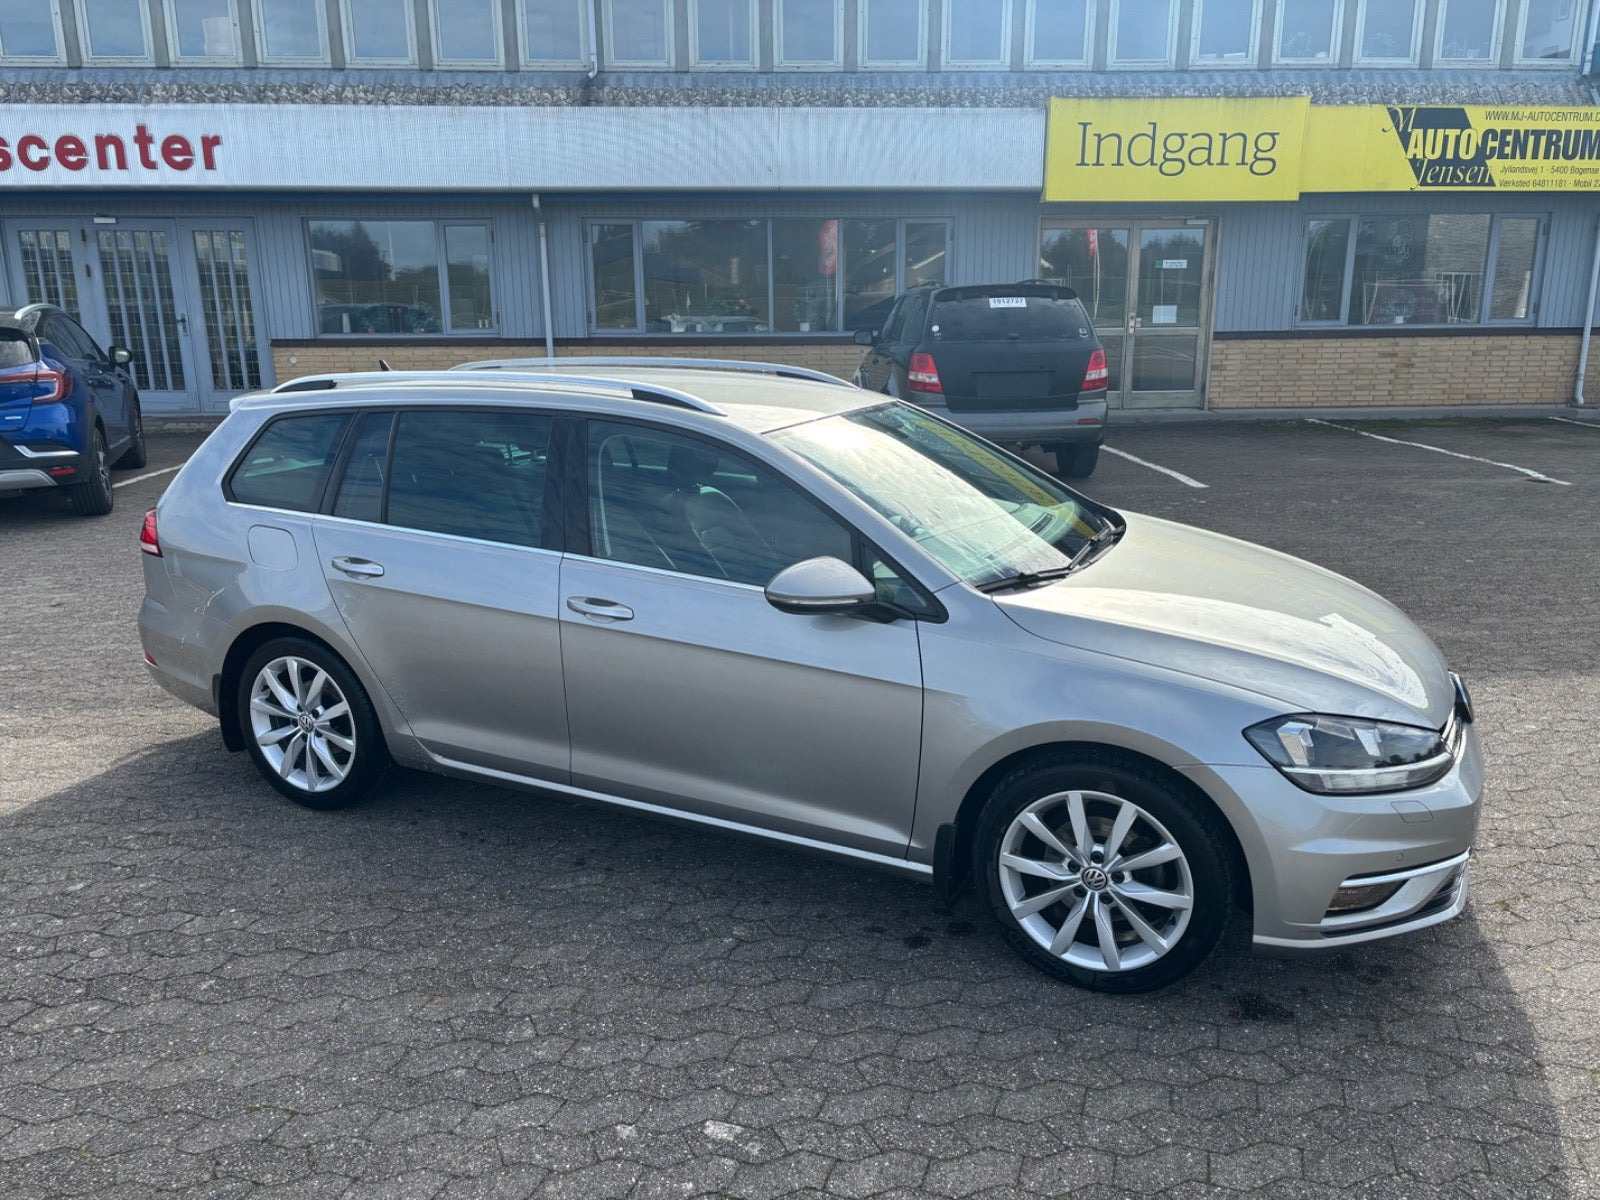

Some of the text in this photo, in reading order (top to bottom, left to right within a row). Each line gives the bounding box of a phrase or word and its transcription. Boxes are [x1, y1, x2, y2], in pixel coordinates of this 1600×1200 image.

[1075, 121, 1280, 177] Indgang
[1405, 128, 1600, 161] AUTO CENTRUM
[1410, 157, 1491, 190] Jensen
[1540, 166, 1544, 174] 1
[1550, 165, 1569, 175] 5400
[1570, 165, 1600, 176] Bogense
[1573, 179, 1592, 188] Mobil
